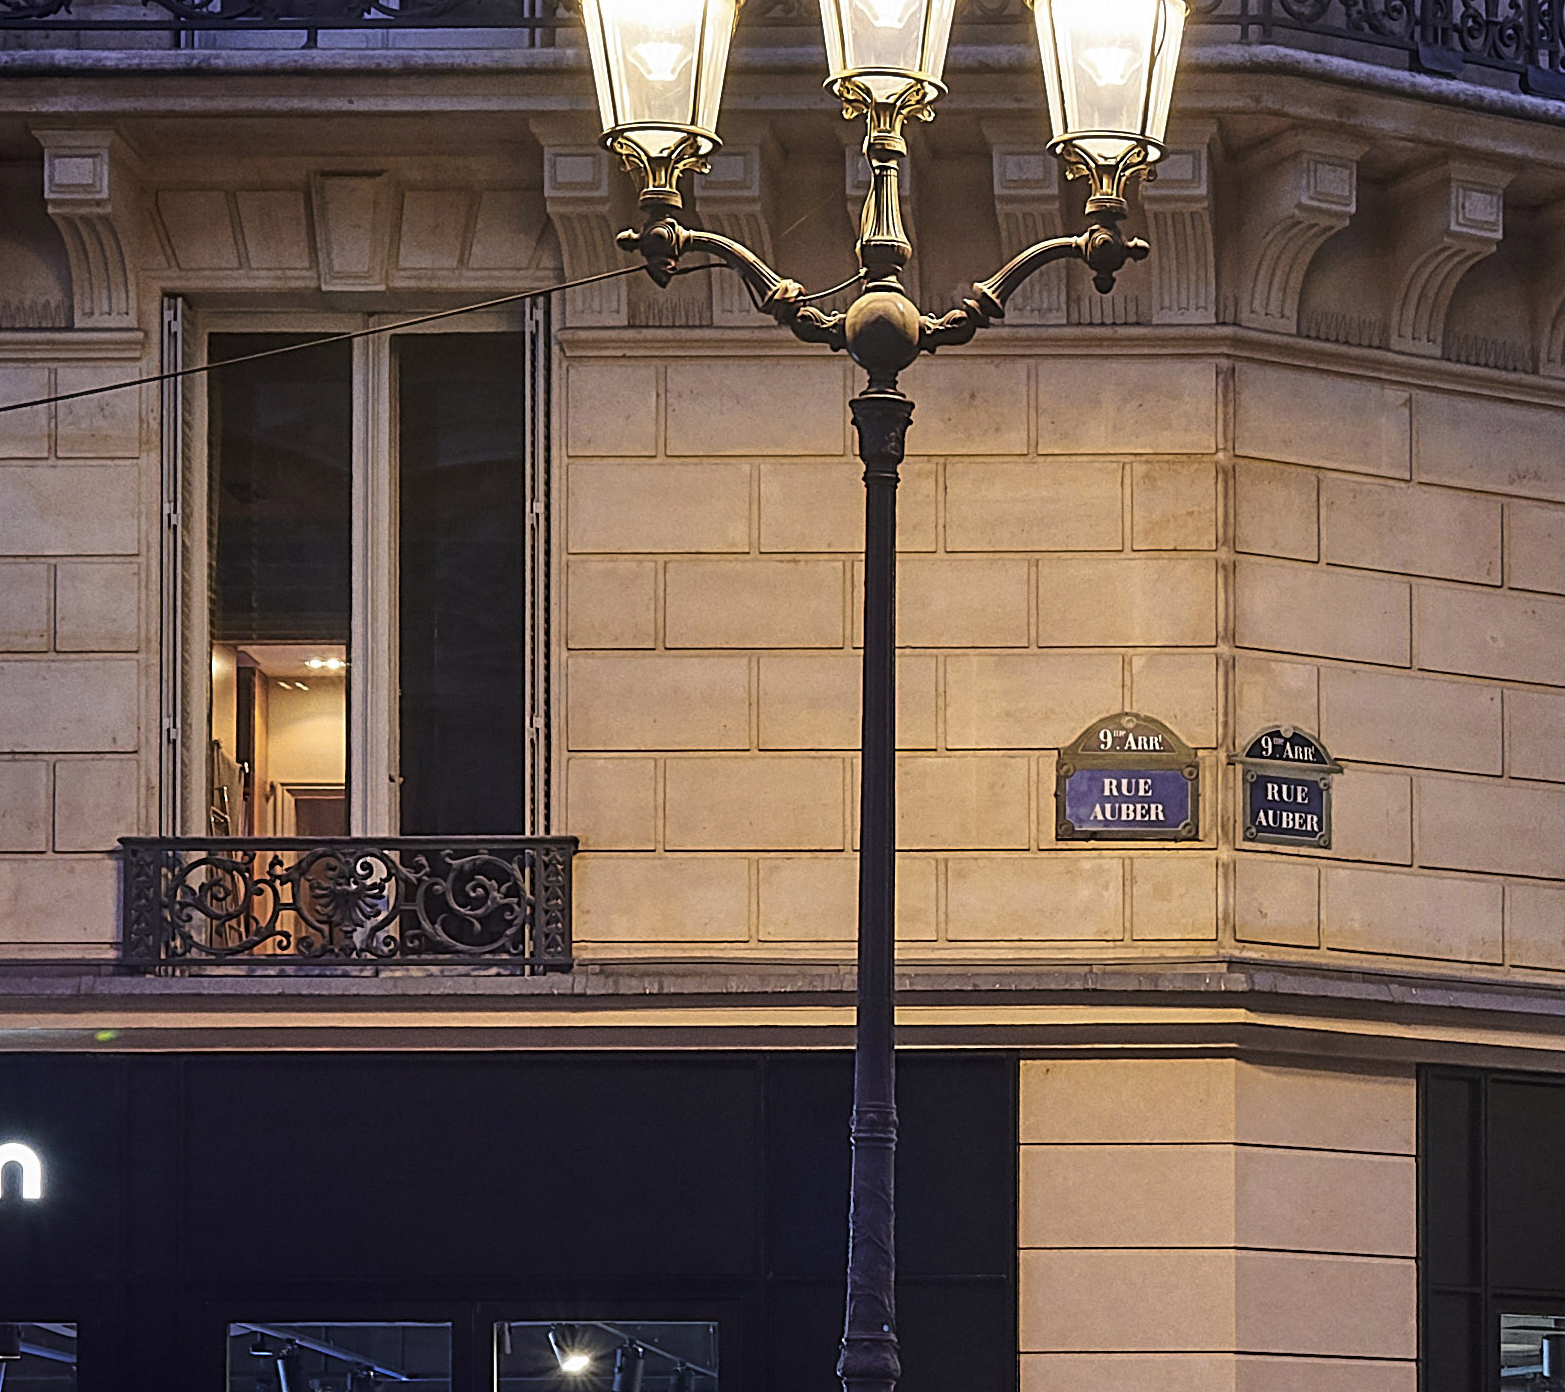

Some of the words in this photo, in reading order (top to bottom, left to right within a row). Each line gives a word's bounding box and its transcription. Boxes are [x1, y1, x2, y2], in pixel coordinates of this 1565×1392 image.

[1103, 778, 1153, 797] RUE
[1266, 782, 1309, 804] RUE
[1090, 803, 1165, 821] AUBER
[1255, 810, 1320, 832] AUBER
